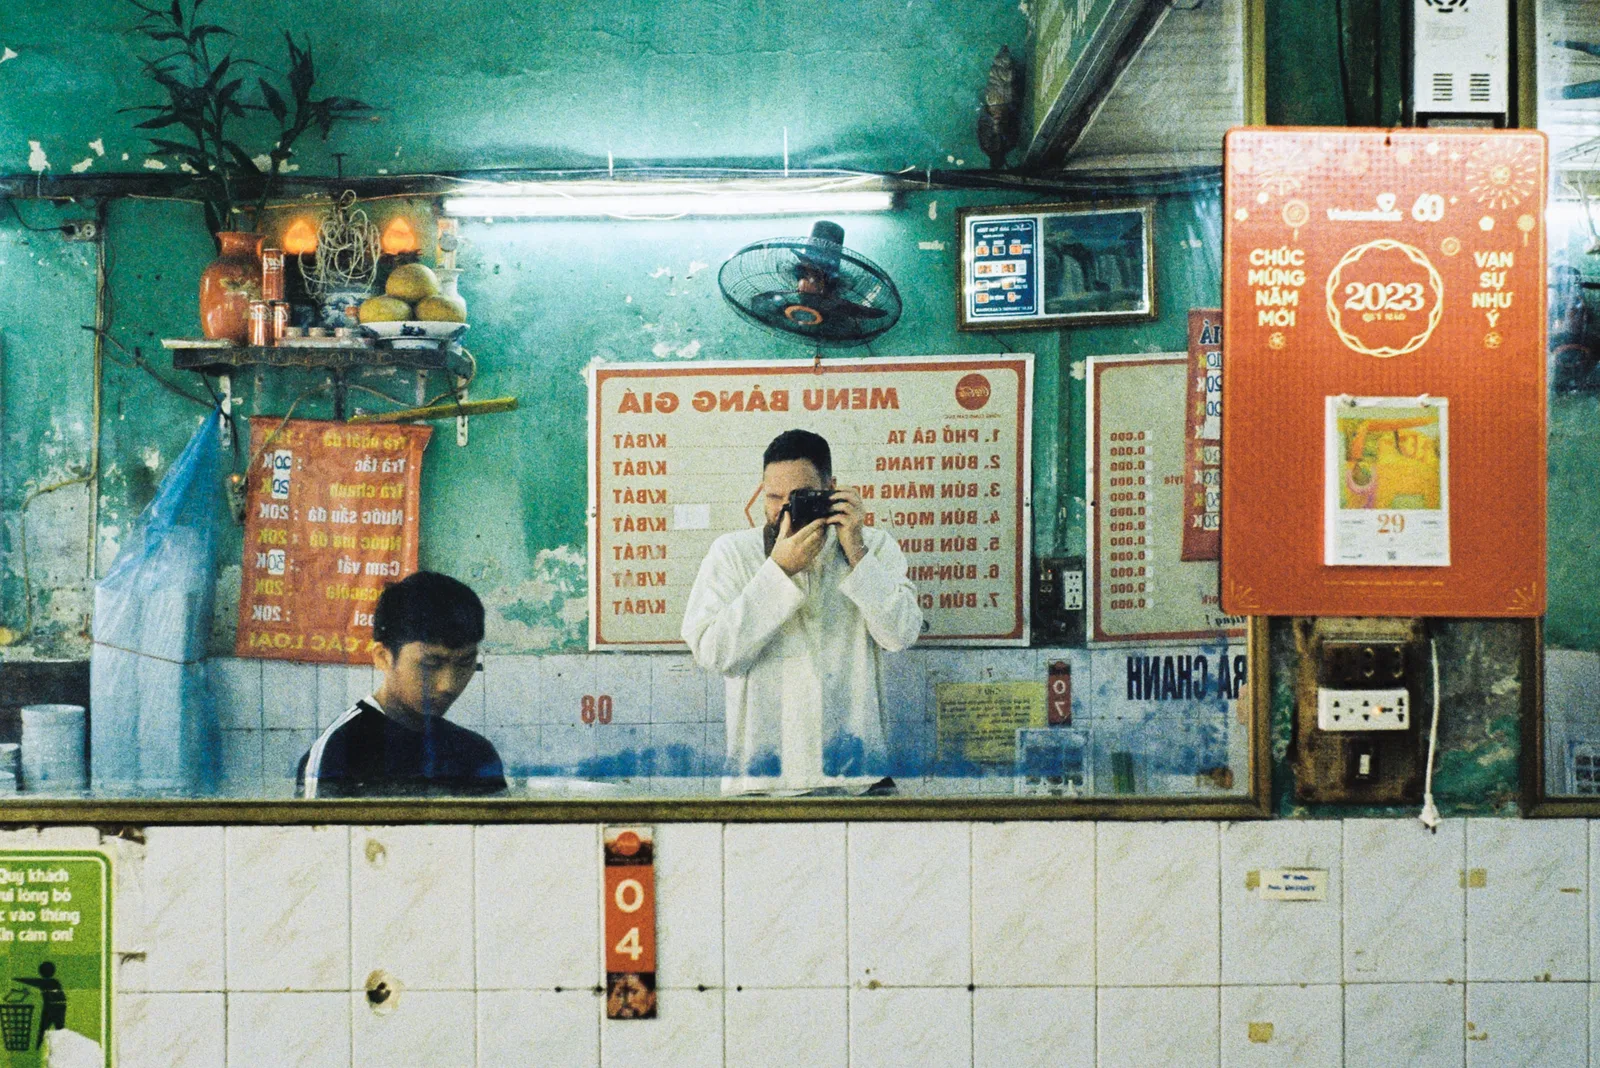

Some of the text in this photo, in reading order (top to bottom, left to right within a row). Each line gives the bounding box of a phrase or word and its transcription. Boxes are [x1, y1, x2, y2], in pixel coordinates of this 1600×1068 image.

[1250, 247, 1305, 266] CHÚC
[1255, 287, 1298, 306] NĂM
[1345, 282, 1424, 310] 2023
[1486, 309, 1499, 328] Ý
[1377, 514, 1405, 533] 29
[0, 868, 69, 885] Quý khách
[18, 888, 49, 905] lòng
[10, 908, 36, 921] vào
[41, 908, 80, 925] thùng
